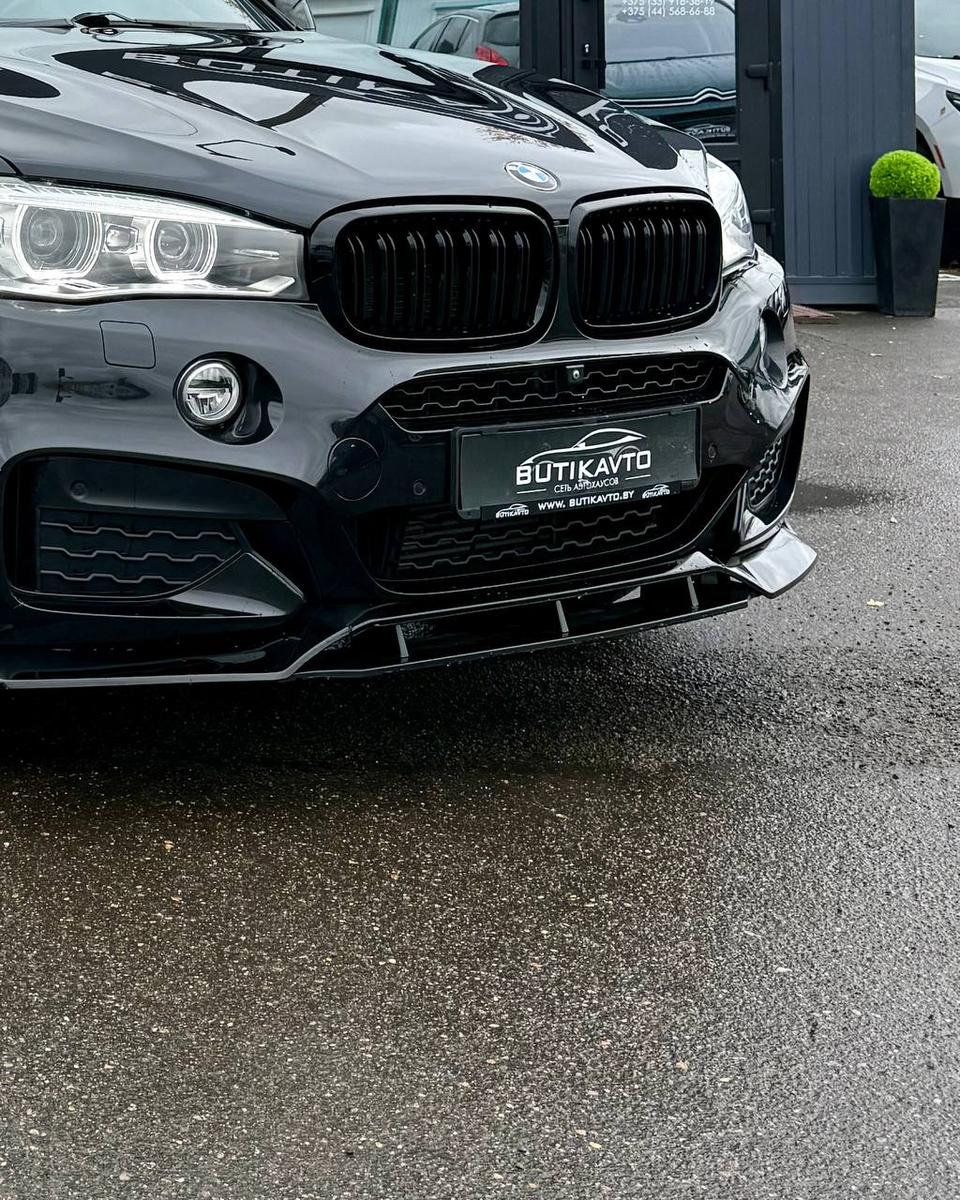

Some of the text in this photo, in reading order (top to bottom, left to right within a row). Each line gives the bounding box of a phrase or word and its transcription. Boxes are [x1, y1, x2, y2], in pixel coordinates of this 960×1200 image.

[622, 6, 716, 17] +375 (44) 568-66-88
[516, 450, 652, 486] BUTIKAVTO
[553, 477, 619, 493] СЕТЬ АВТОХАУСОВ
